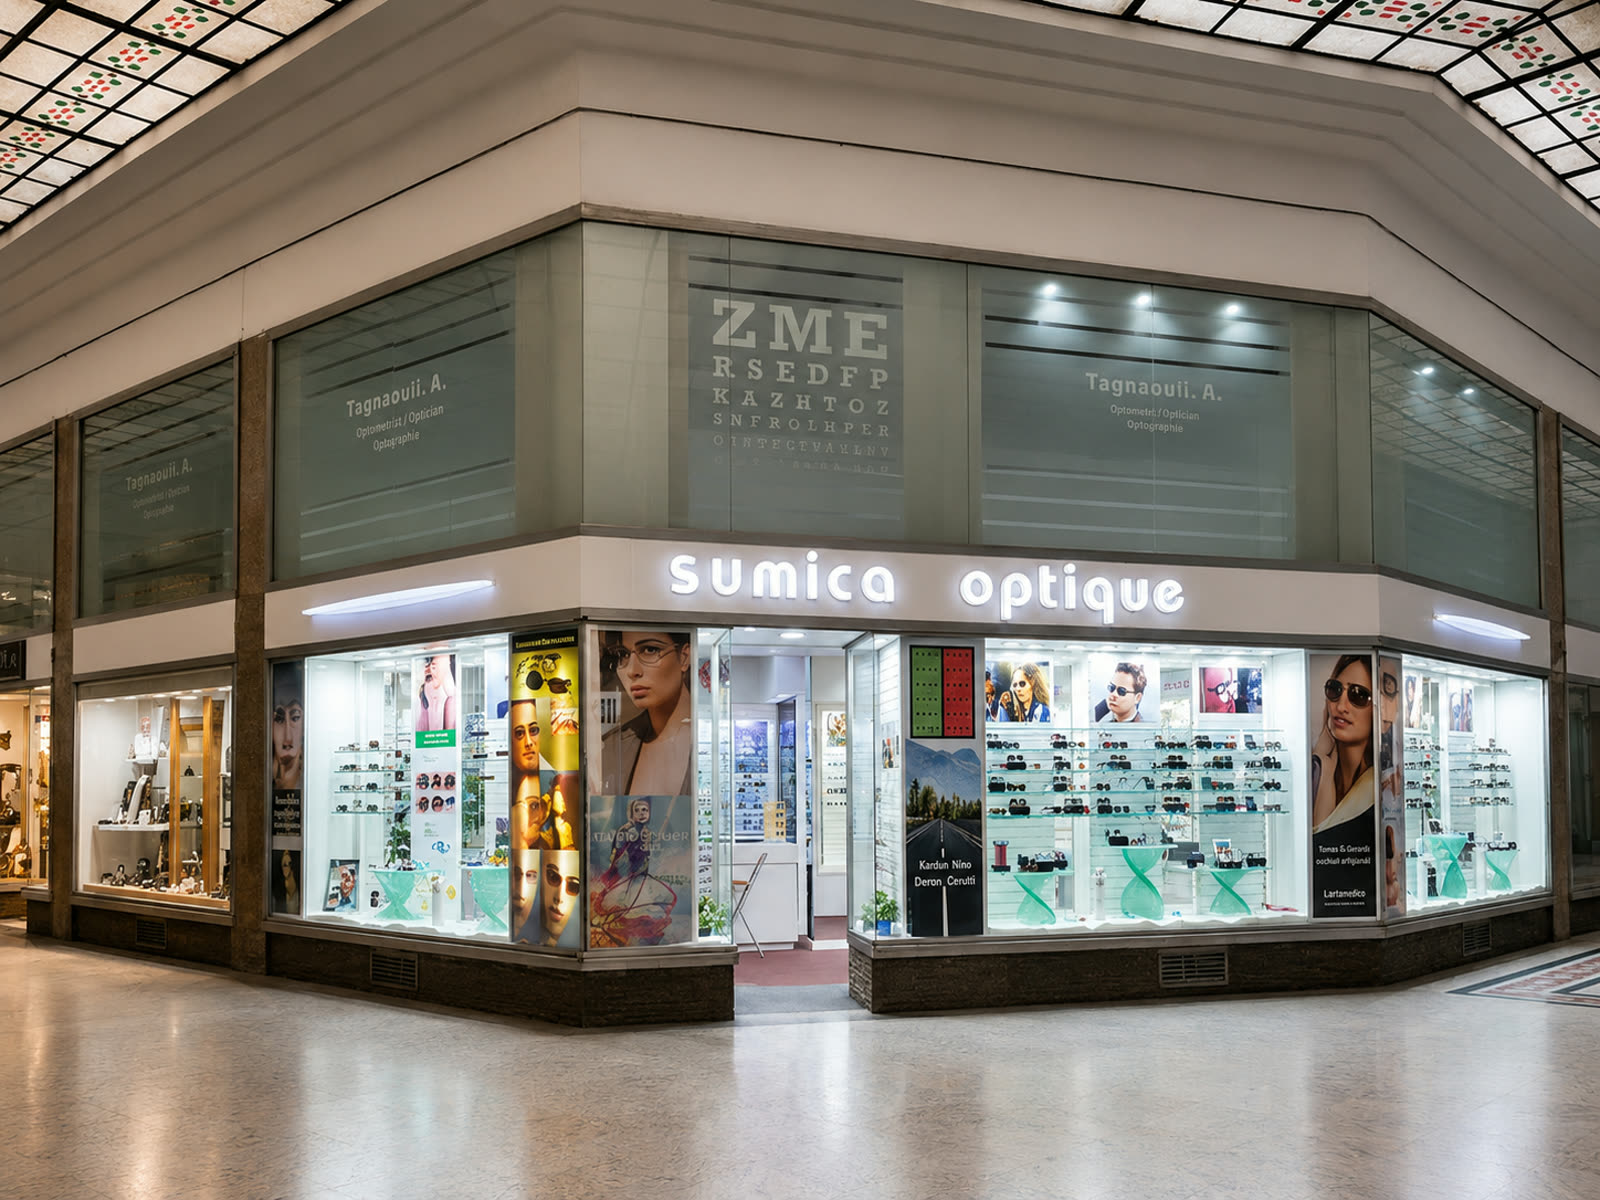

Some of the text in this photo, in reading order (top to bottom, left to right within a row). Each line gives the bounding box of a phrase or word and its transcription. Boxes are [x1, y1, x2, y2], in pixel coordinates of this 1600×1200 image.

[430, 373, 447, 393] A.
[1202, 383, 1222, 401] A.
[669, 550, 1186, 625] sumica optique
[919, 859, 972, 870] Kardun Nino
[914, 876, 942, 887] Deron
